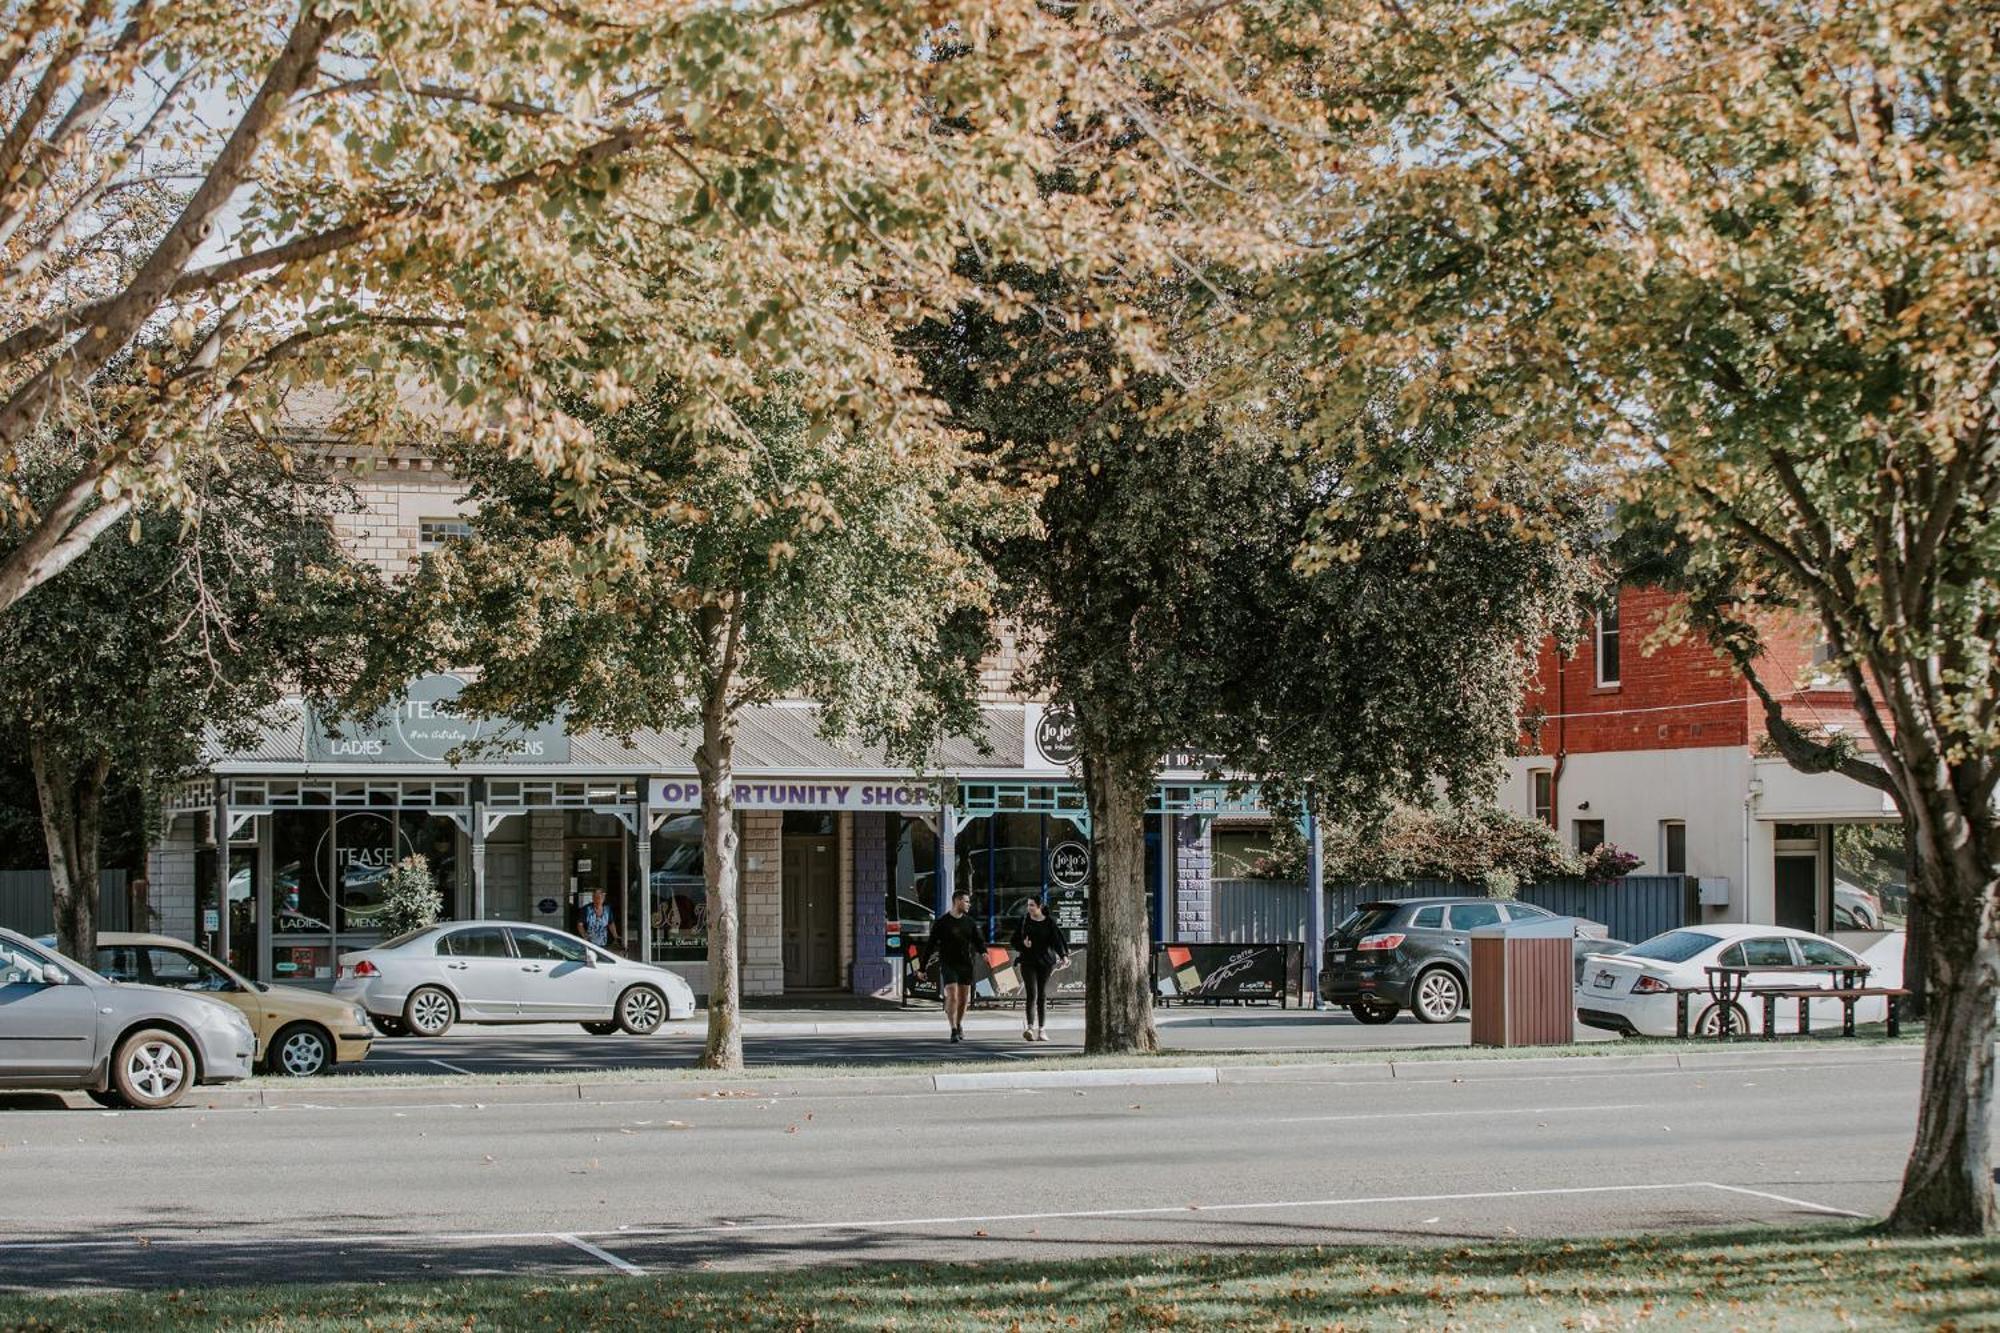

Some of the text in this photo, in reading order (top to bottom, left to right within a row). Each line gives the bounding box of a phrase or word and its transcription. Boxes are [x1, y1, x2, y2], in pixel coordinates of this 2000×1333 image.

[331, 740, 384, 755] LADIES
[662, 783, 929, 805] OPRTUNITY SHOP
[336, 848, 394, 866] TEASE
